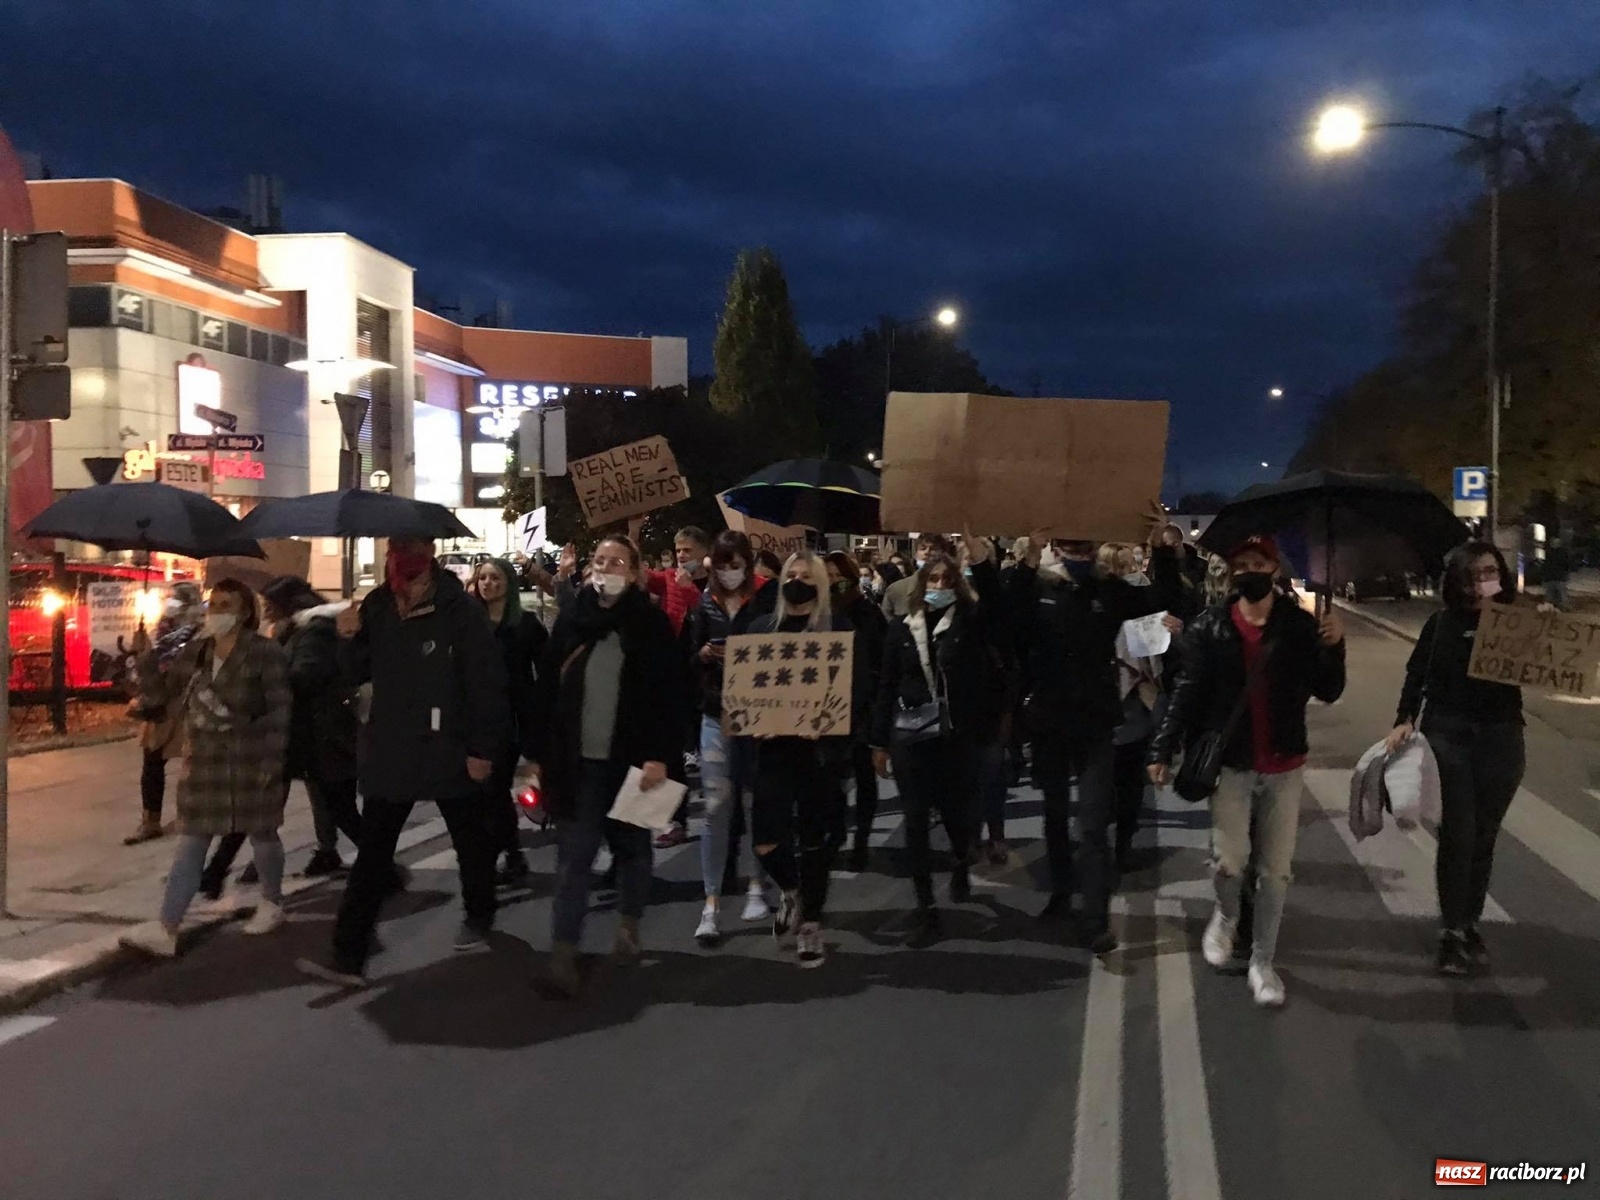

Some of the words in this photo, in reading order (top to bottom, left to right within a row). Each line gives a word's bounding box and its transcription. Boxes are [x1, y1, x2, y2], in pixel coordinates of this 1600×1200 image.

[574, 452, 623, 480] REAL
[624, 444, 660, 464] MEN
[585, 475, 681, 517] FEMINISTS
[1462, 471, 1486, 497] P
[1491, 608, 1521, 630] TO
[1560, 647, 1582, 667] Z
